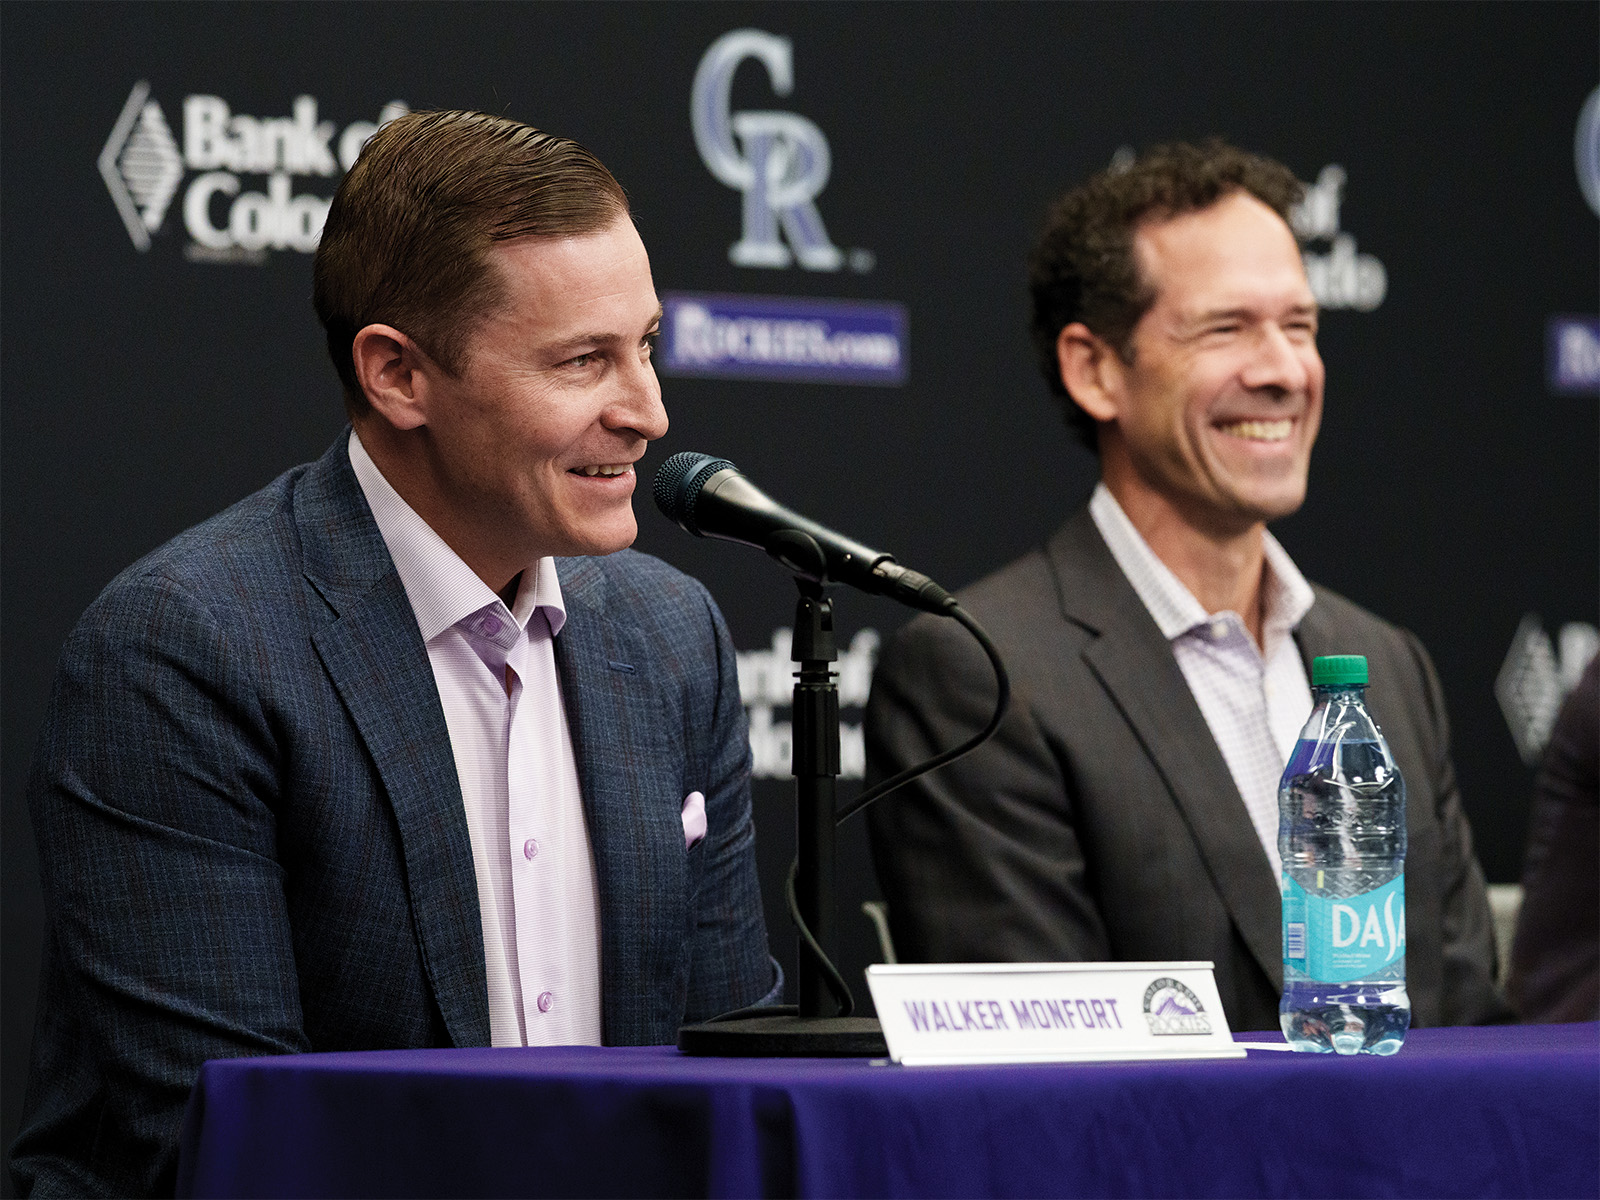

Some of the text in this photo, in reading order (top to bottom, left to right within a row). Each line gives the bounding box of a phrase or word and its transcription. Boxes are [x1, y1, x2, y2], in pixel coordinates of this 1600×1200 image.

[183, 94, 337, 176] Bank
[182, 171, 335, 253] Colo
[902, 998, 1124, 1032] WALKER MONFORT
